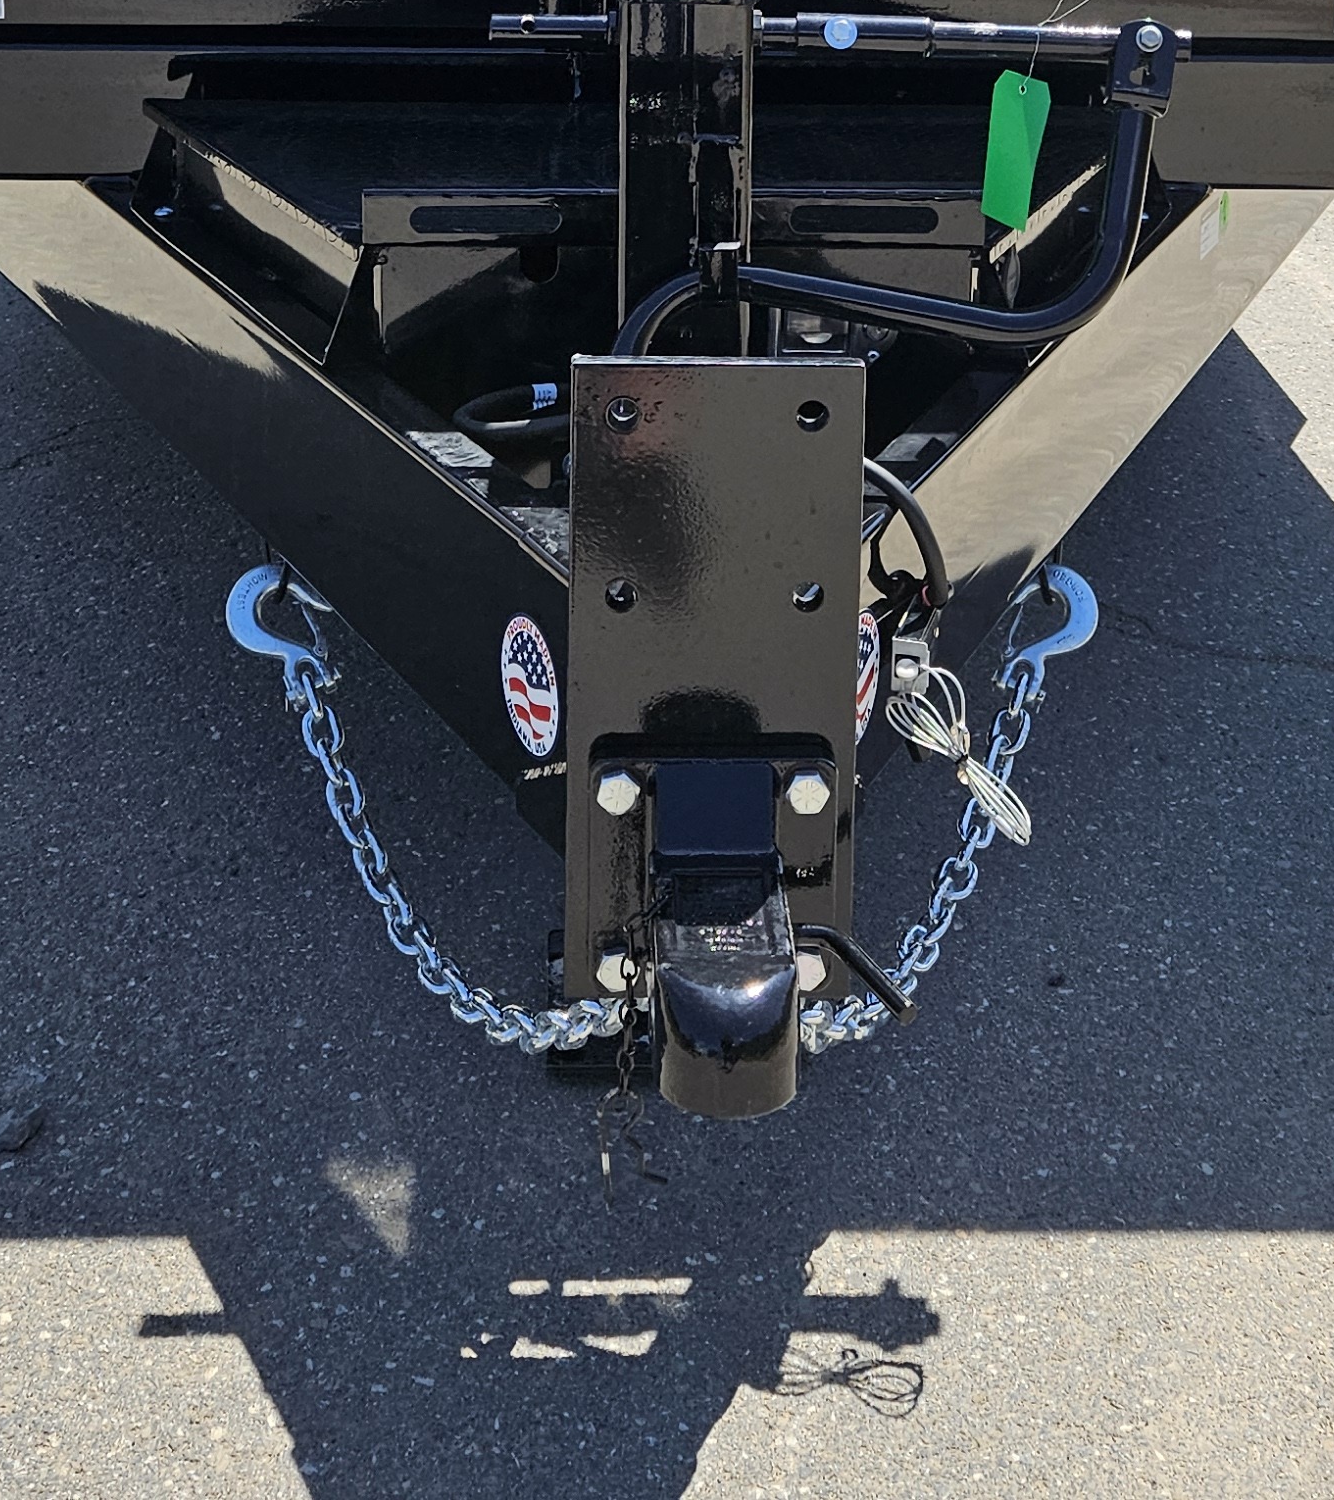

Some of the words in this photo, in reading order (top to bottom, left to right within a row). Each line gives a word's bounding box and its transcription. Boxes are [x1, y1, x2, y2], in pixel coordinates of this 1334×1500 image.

[507, 618, 533, 640] PROUDLY
[534, 630, 551, 665] MADE
[533, 740, 547, 755] USA
